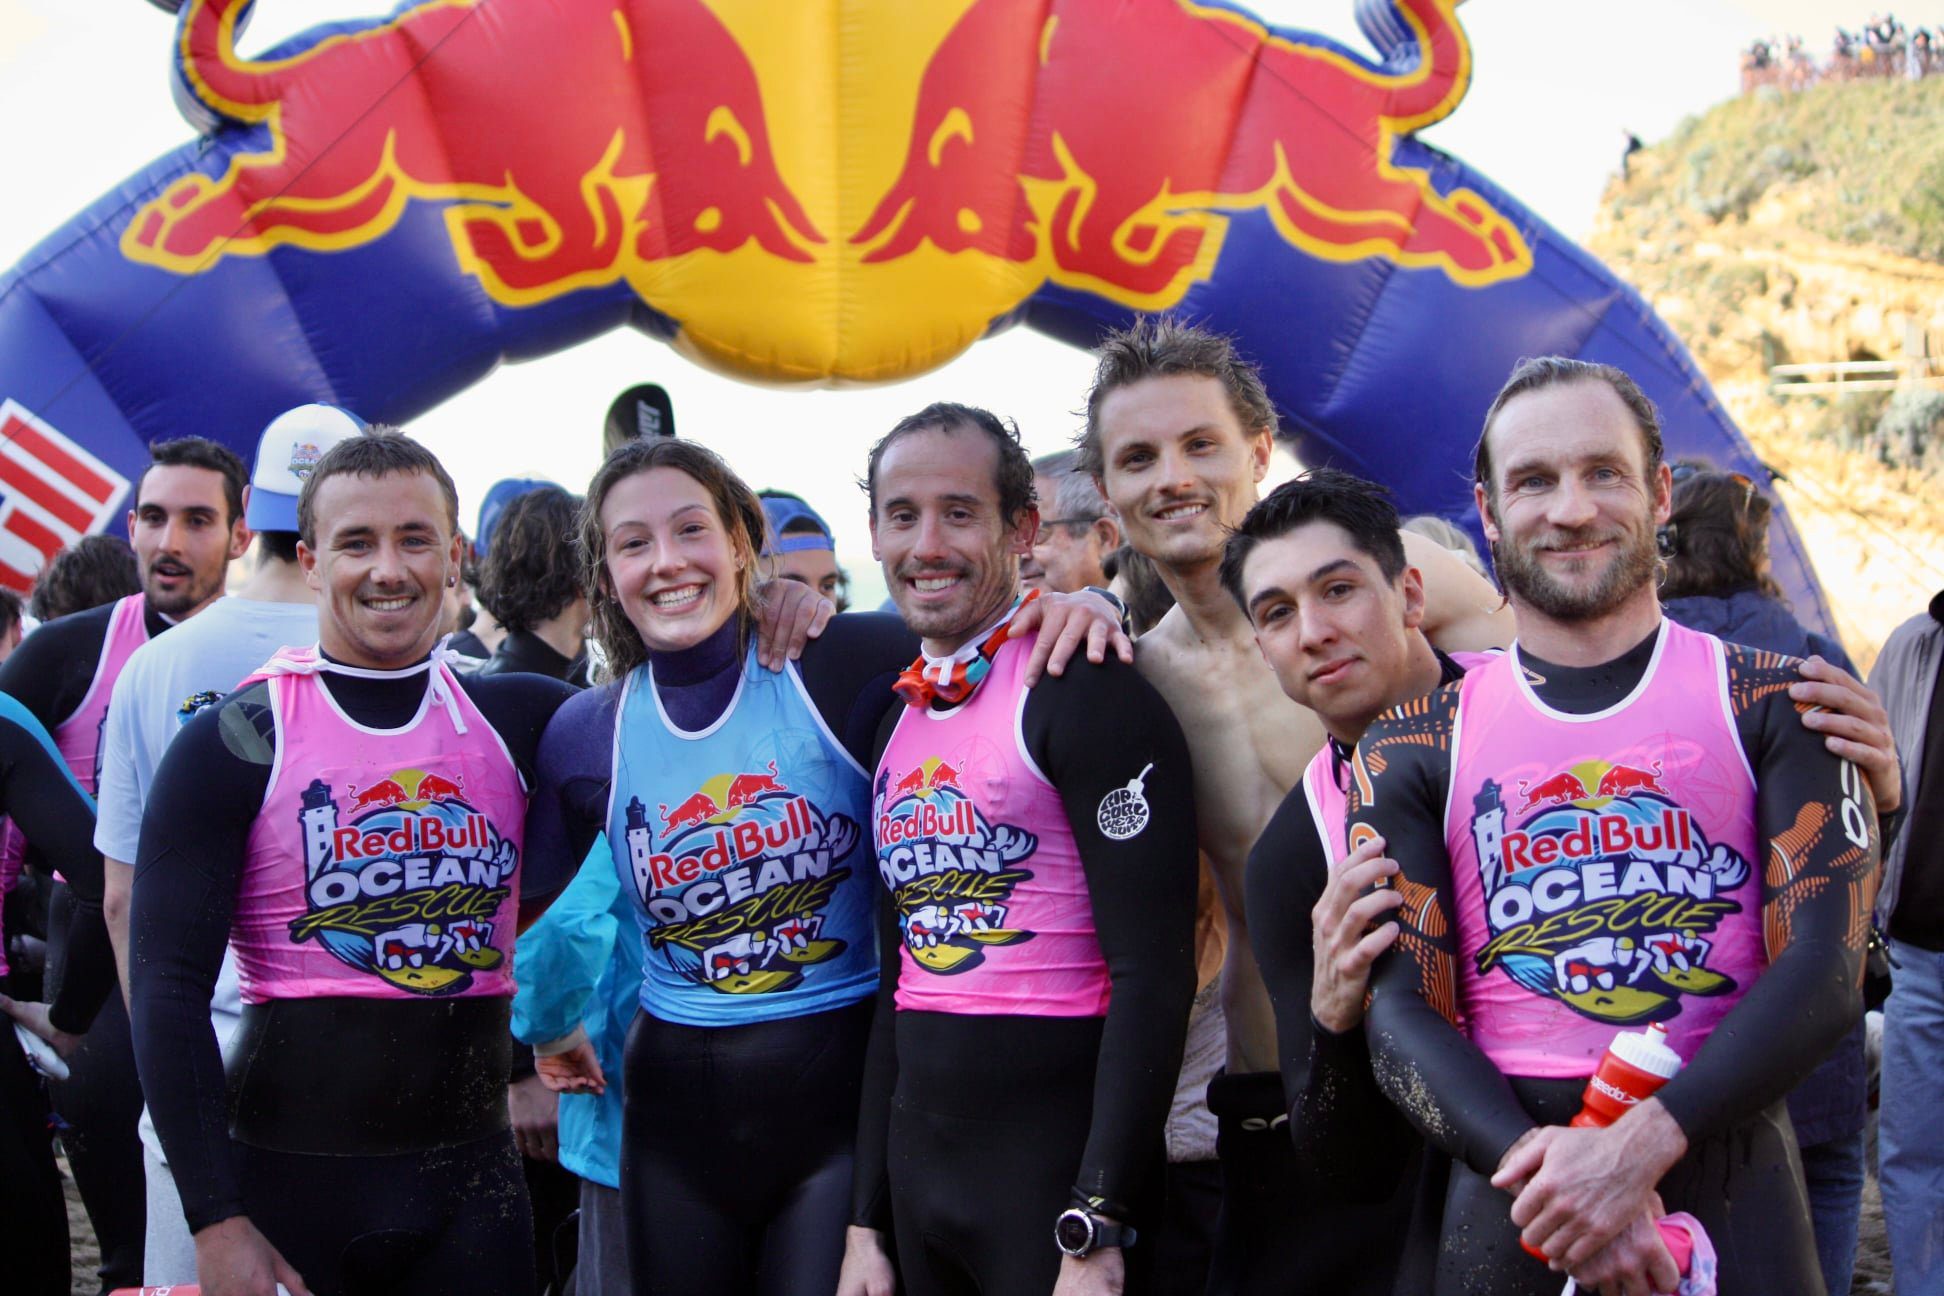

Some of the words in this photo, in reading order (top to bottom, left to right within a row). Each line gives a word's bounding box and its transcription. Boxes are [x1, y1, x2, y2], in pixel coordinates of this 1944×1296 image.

[880, 804, 920, 849] Red
[923, 800, 977, 837] Bull
[1101, 789, 1132, 811] RIP
[333, 817, 414, 862] Red
[420, 814, 490, 850] Bull
[649, 831, 730, 890] Red
[733, 797, 813, 861] Bull
[1501, 816, 1592, 874] Red
[1600, 810, 1692, 854] Bull
[310, 857, 501, 908] OCEAN
[649, 850, 831, 923] OCEAN
[879, 843, 1002, 892] OCEAN
[894, 869, 1026, 916] RESCUE
[292, 884, 508, 938] RESCUE
[651, 870, 848, 950] RESCUE
[1489, 861, 1716, 931] OCEAN
[1477, 891, 1738, 970] RESCUE
